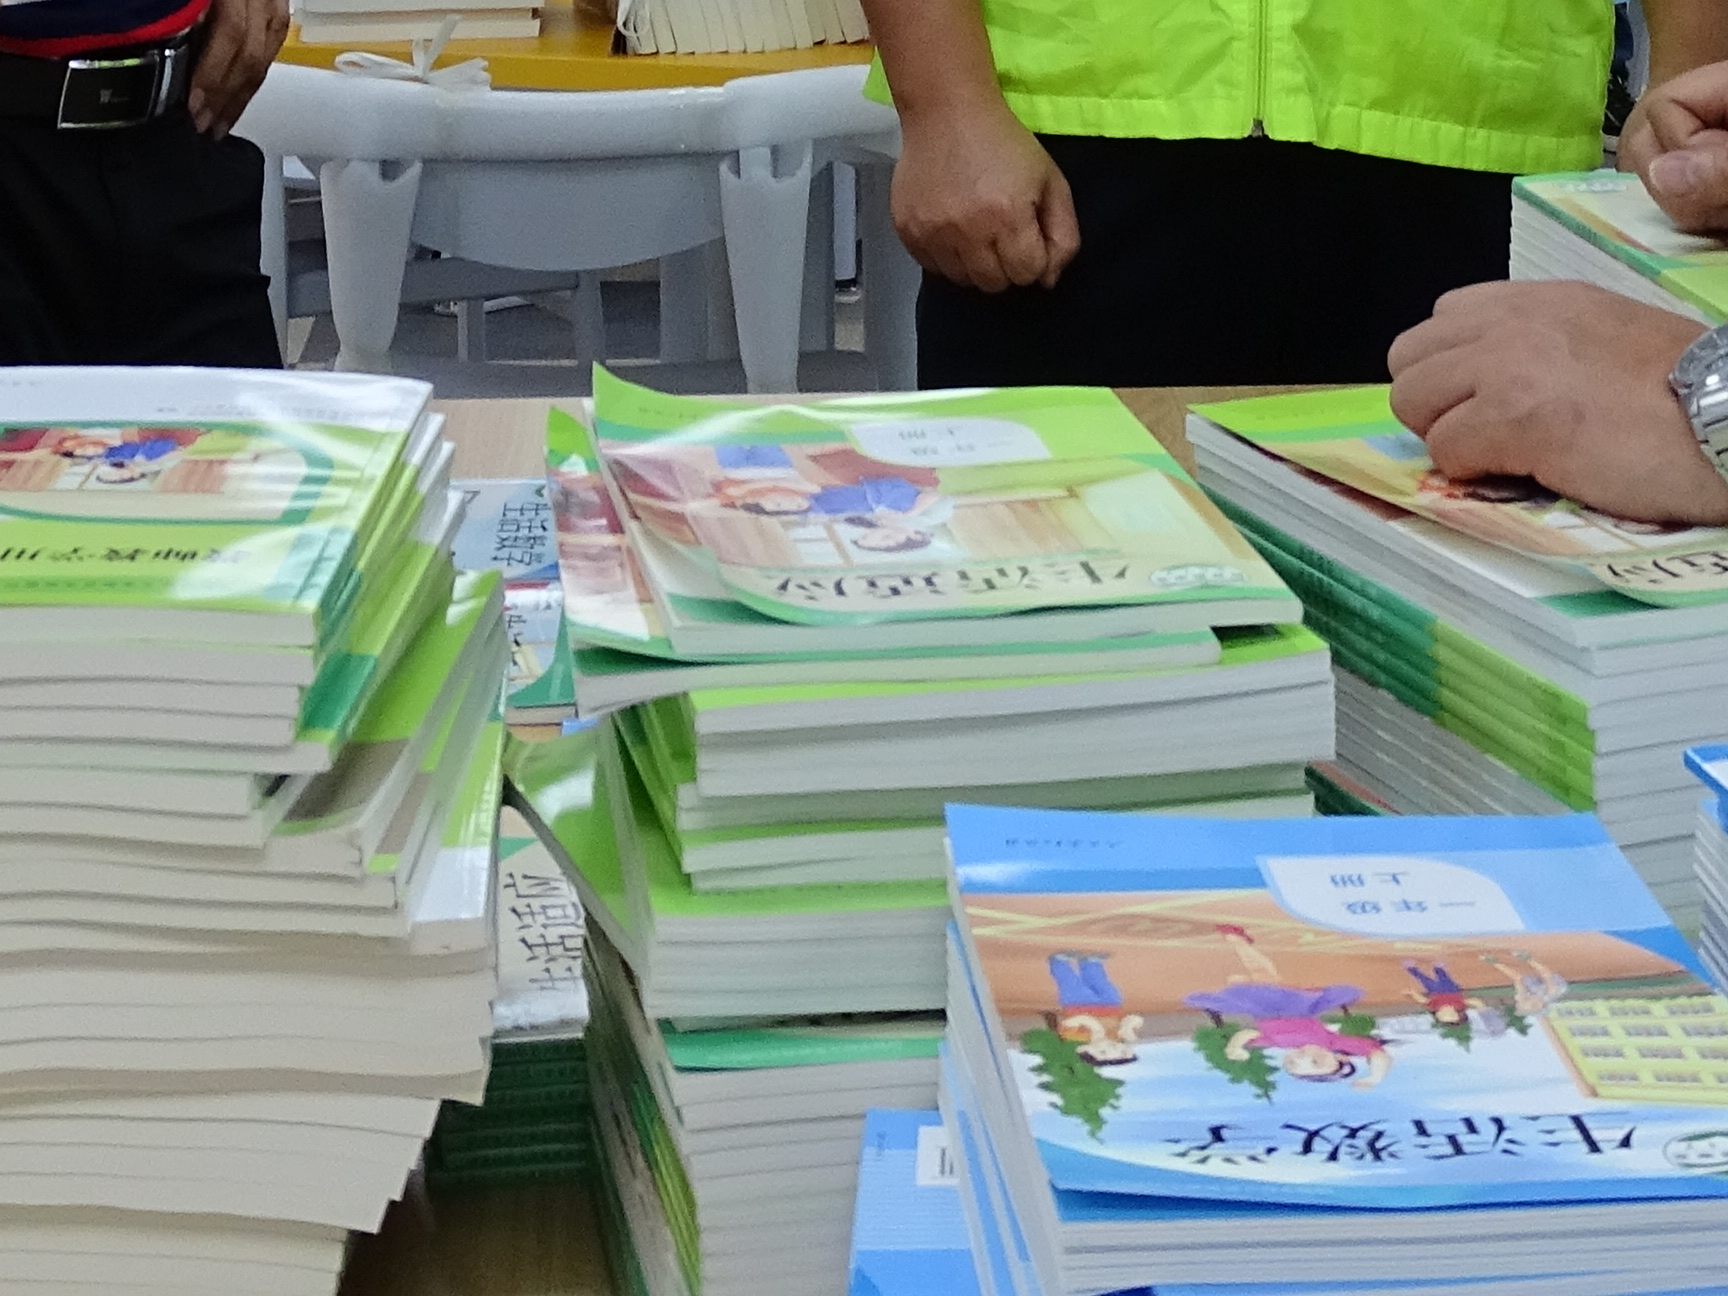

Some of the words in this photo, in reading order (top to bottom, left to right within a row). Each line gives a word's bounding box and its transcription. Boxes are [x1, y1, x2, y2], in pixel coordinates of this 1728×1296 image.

[1329, 870, 1412, 890] 上册
[1164, 1112, 1642, 1167] 生活数学
